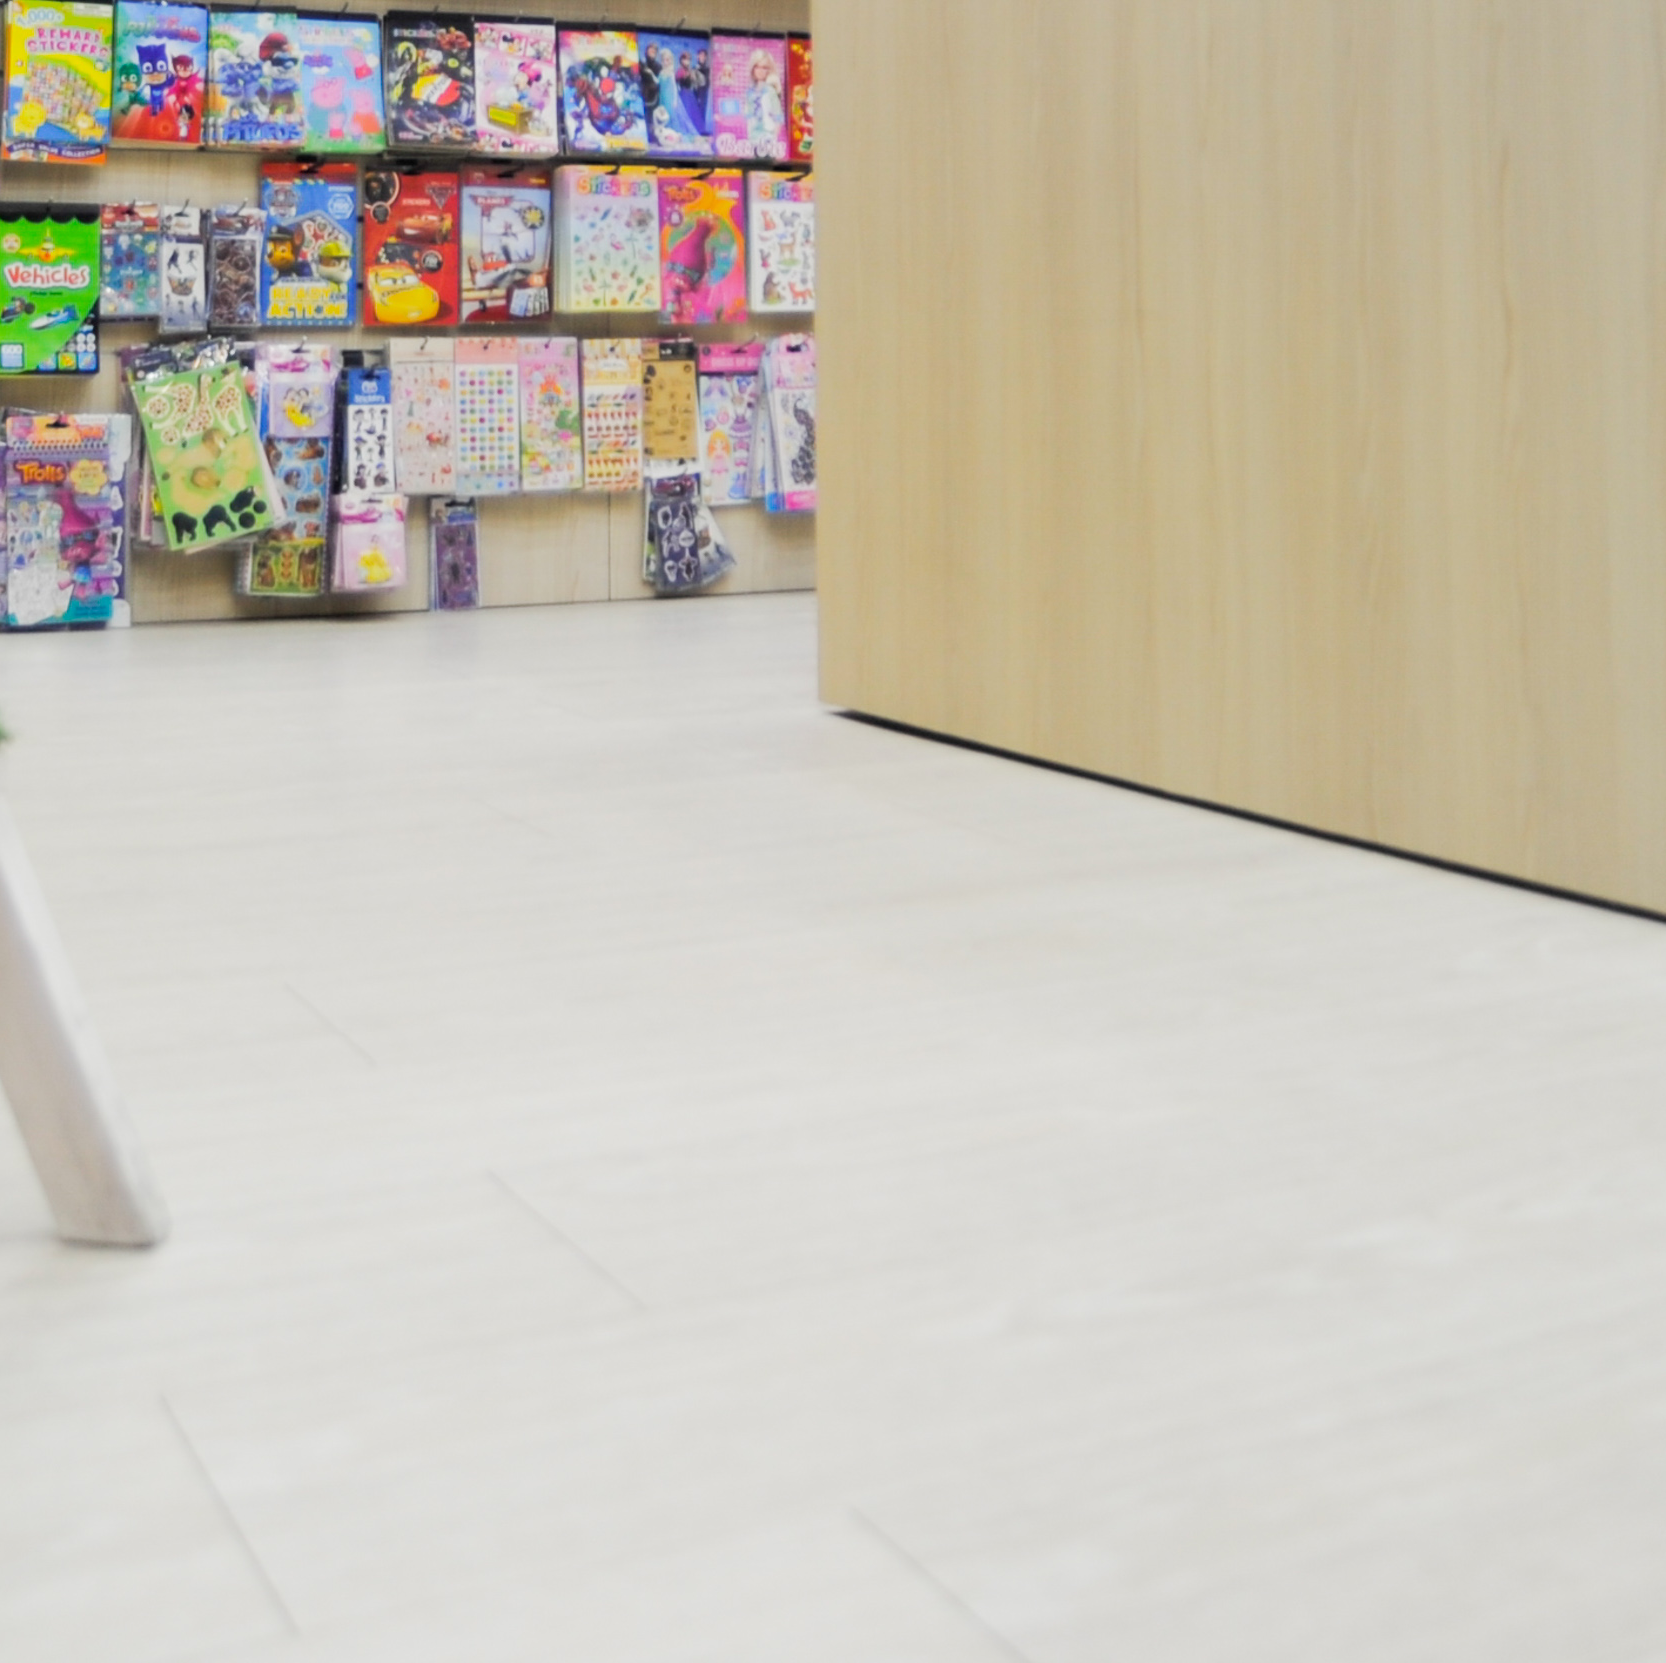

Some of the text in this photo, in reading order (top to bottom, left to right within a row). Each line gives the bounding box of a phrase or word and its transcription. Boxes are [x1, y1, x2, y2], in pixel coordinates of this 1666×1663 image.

[36, 27, 101, 43] REWARD
[27, 39, 110, 57] STICKERS
[6, 264, 88, 286] Vehicles
[270, 286, 331, 301] READY
[15, 460, 66, 484] Trolls
